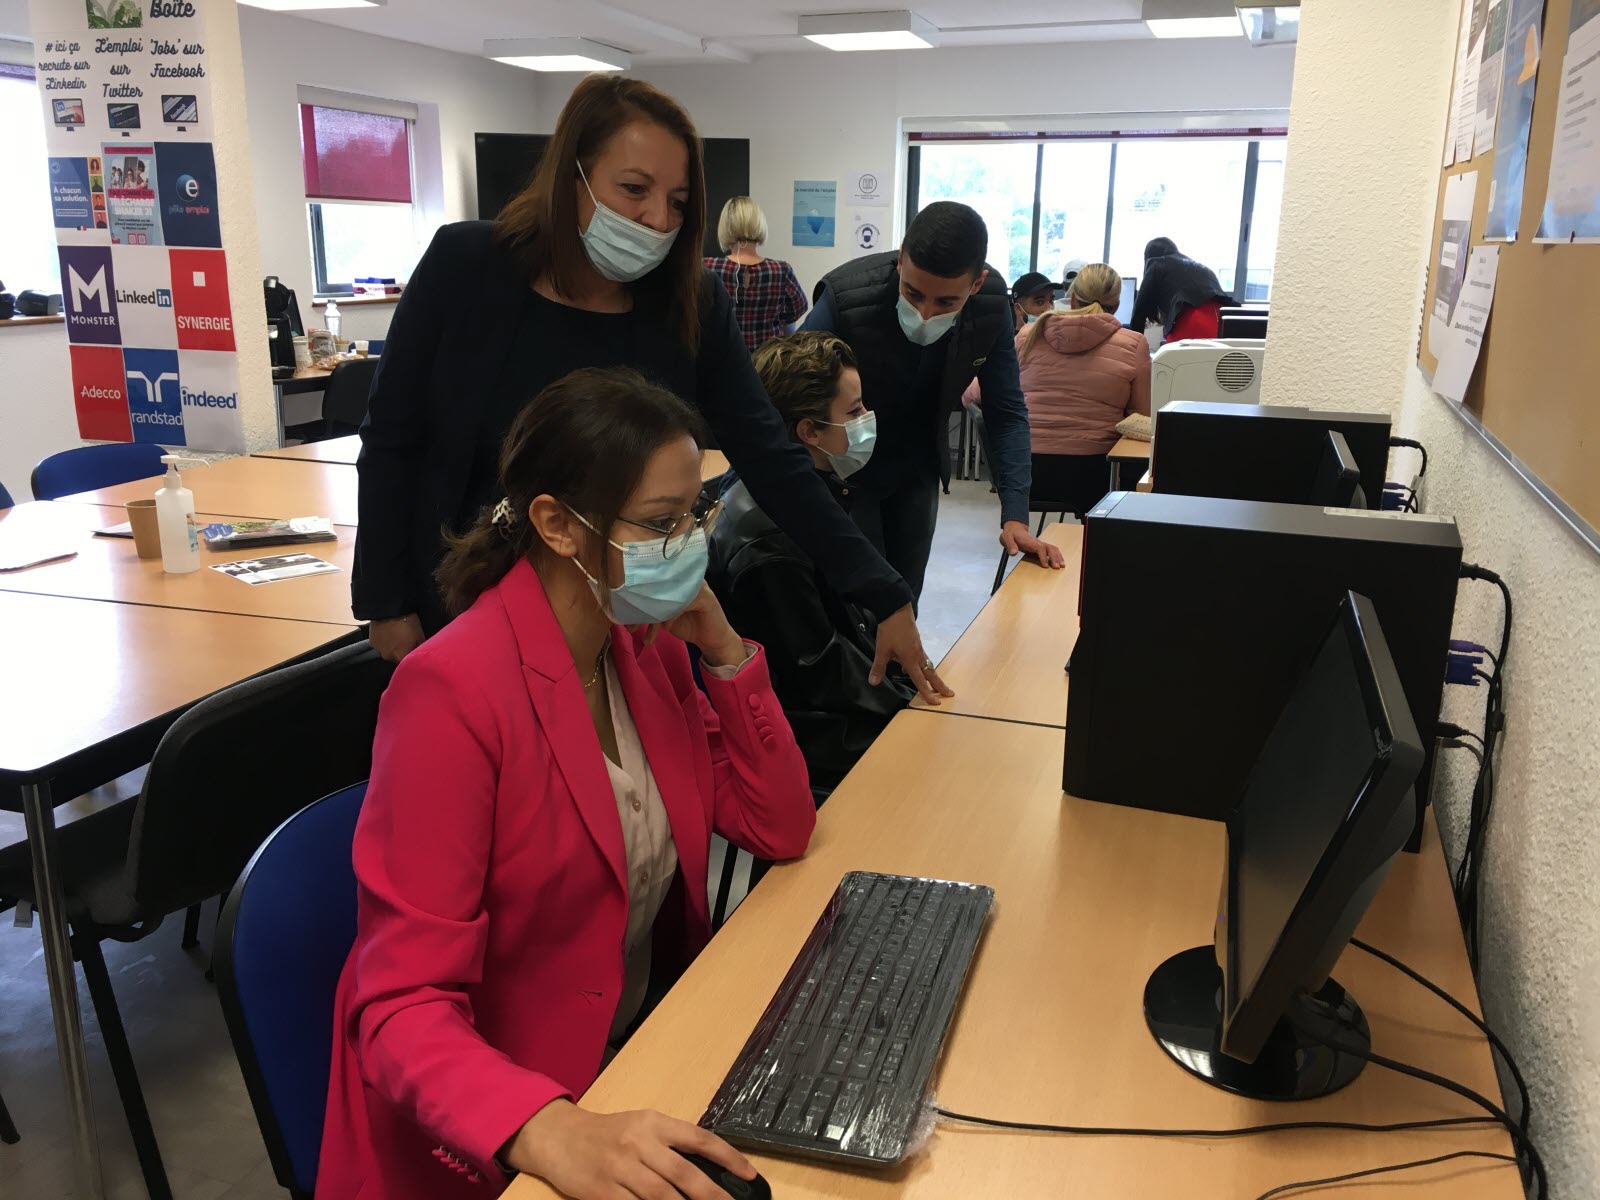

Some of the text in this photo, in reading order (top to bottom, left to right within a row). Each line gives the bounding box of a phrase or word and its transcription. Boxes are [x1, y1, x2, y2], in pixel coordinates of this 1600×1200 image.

[45, 40, 80, 55] # ici ça
[95, 37, 143, 56] L'emploi
[183, 43, 204, 54] sur
[38, 59, 90, 71] recrute sur
[110, 64, 131, 75] sur
[150, 63, 205, 78] Facebook
[46, 77, 86, 90] Linkedin
[102, 83, 143, 98] Twitter
[60, 186, 82, 194] chacun
[71, 315, 116, 326] MONSTER
[178, 316, 231, 330] SYNERGIE
[81, 386, 121, 399] Adecco
[181, 387, 236, 410] indeed
[132, 410, 182, 426] randstad
